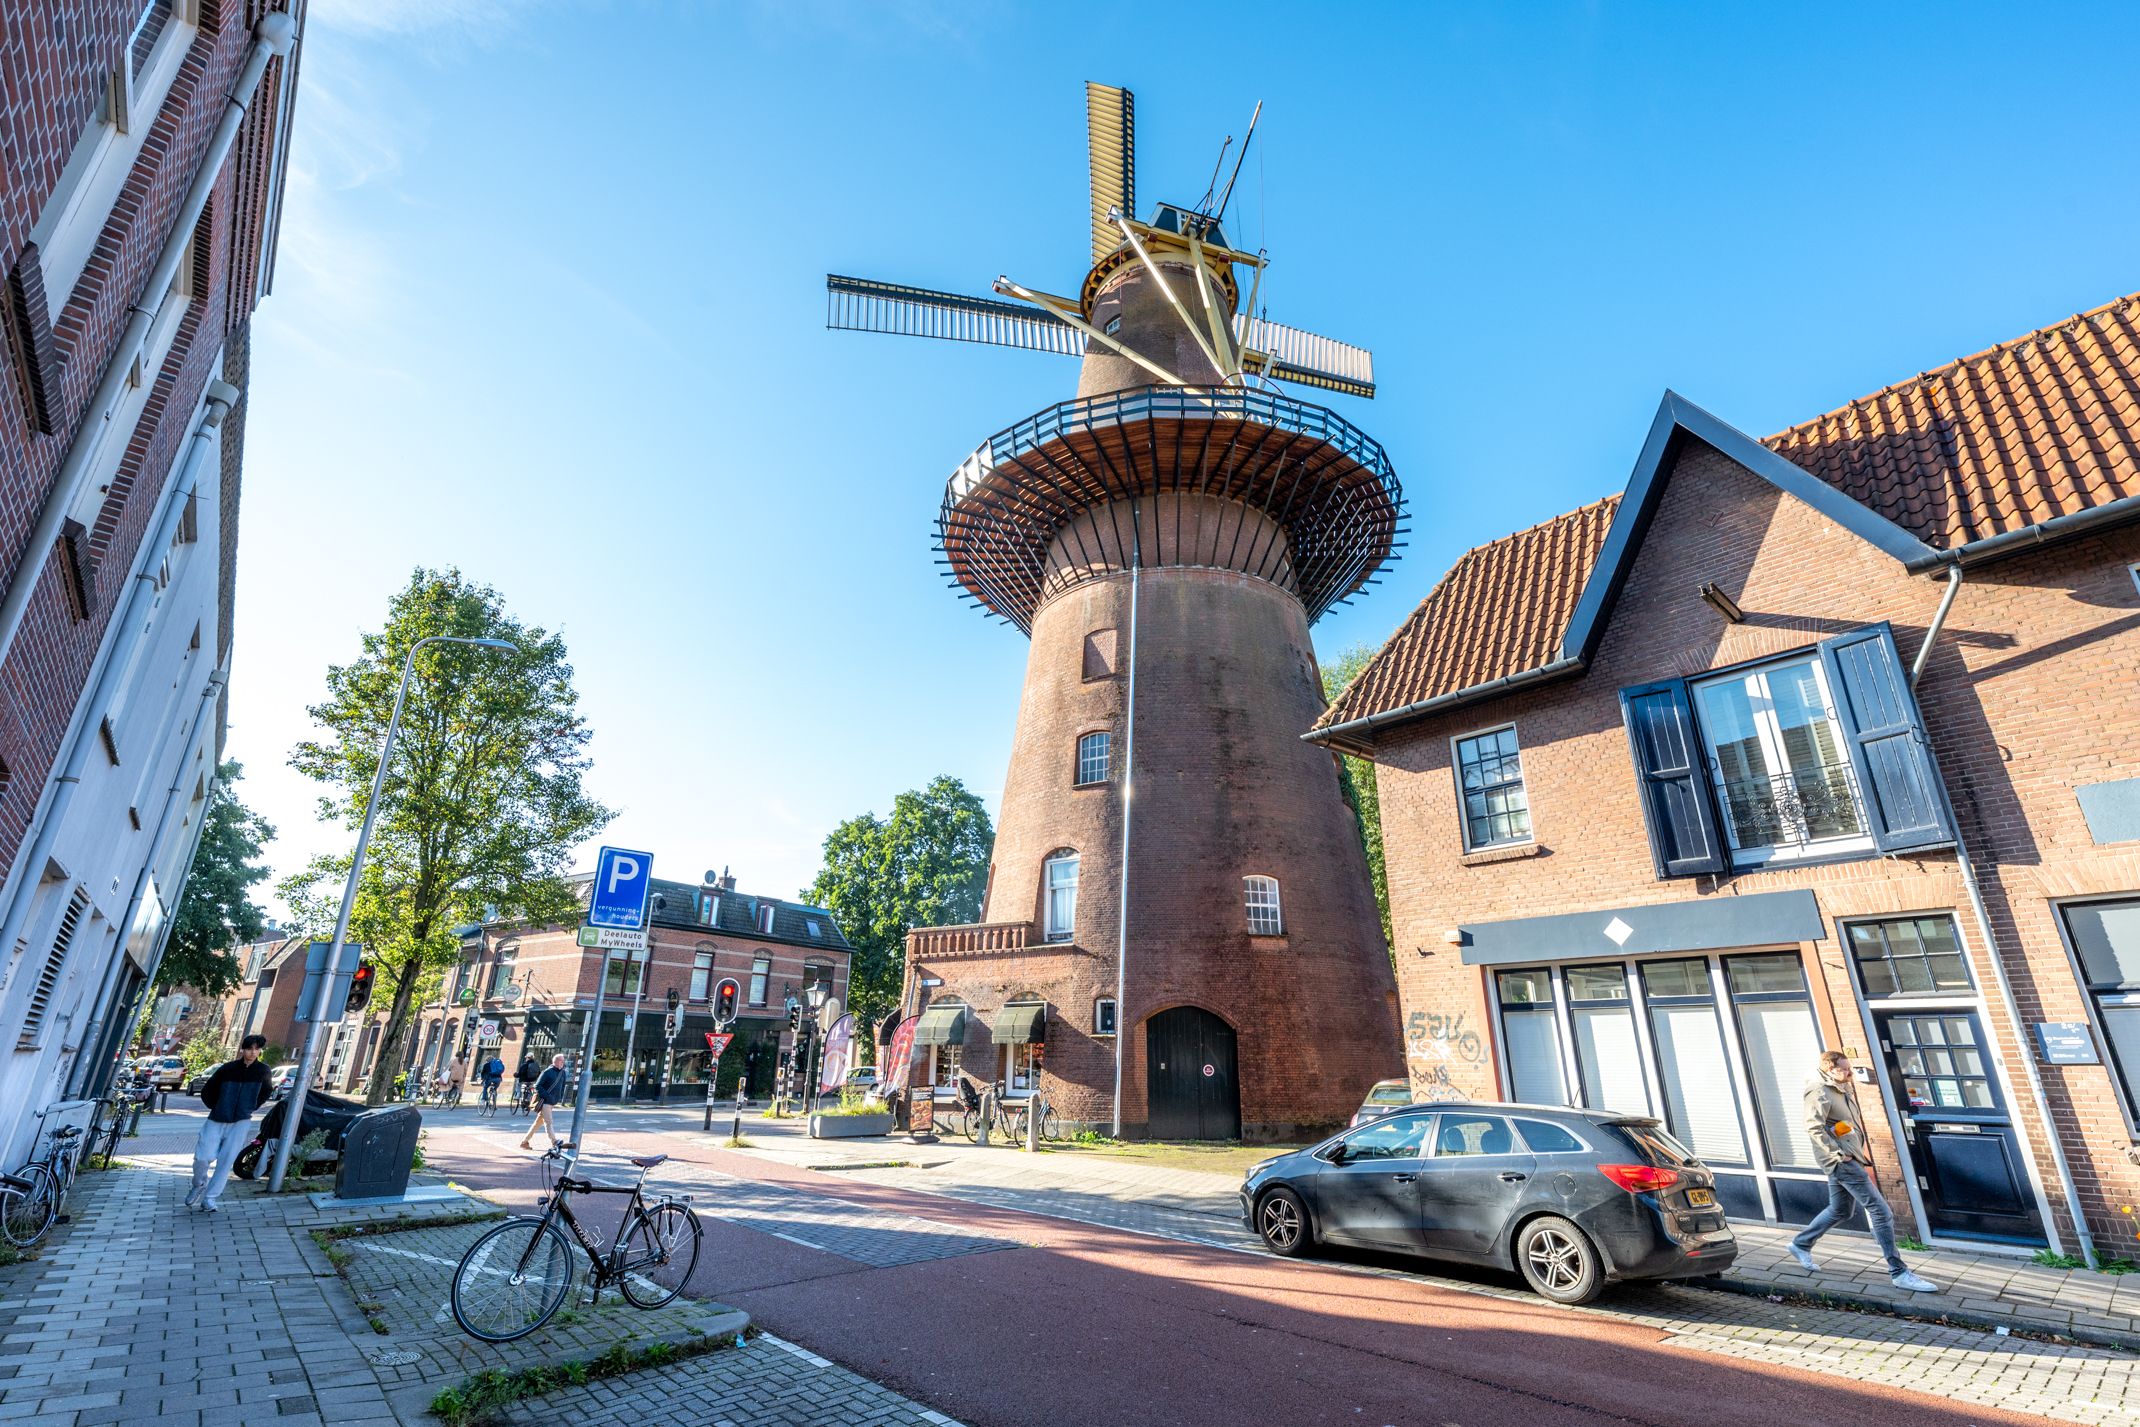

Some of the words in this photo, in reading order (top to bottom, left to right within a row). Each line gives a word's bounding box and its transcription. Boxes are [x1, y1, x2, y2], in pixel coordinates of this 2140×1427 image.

[608, 855, 640, 894] P
[604, 930, 642, 940] Deelauto
[600, 939, 643, 949] MyWheels
